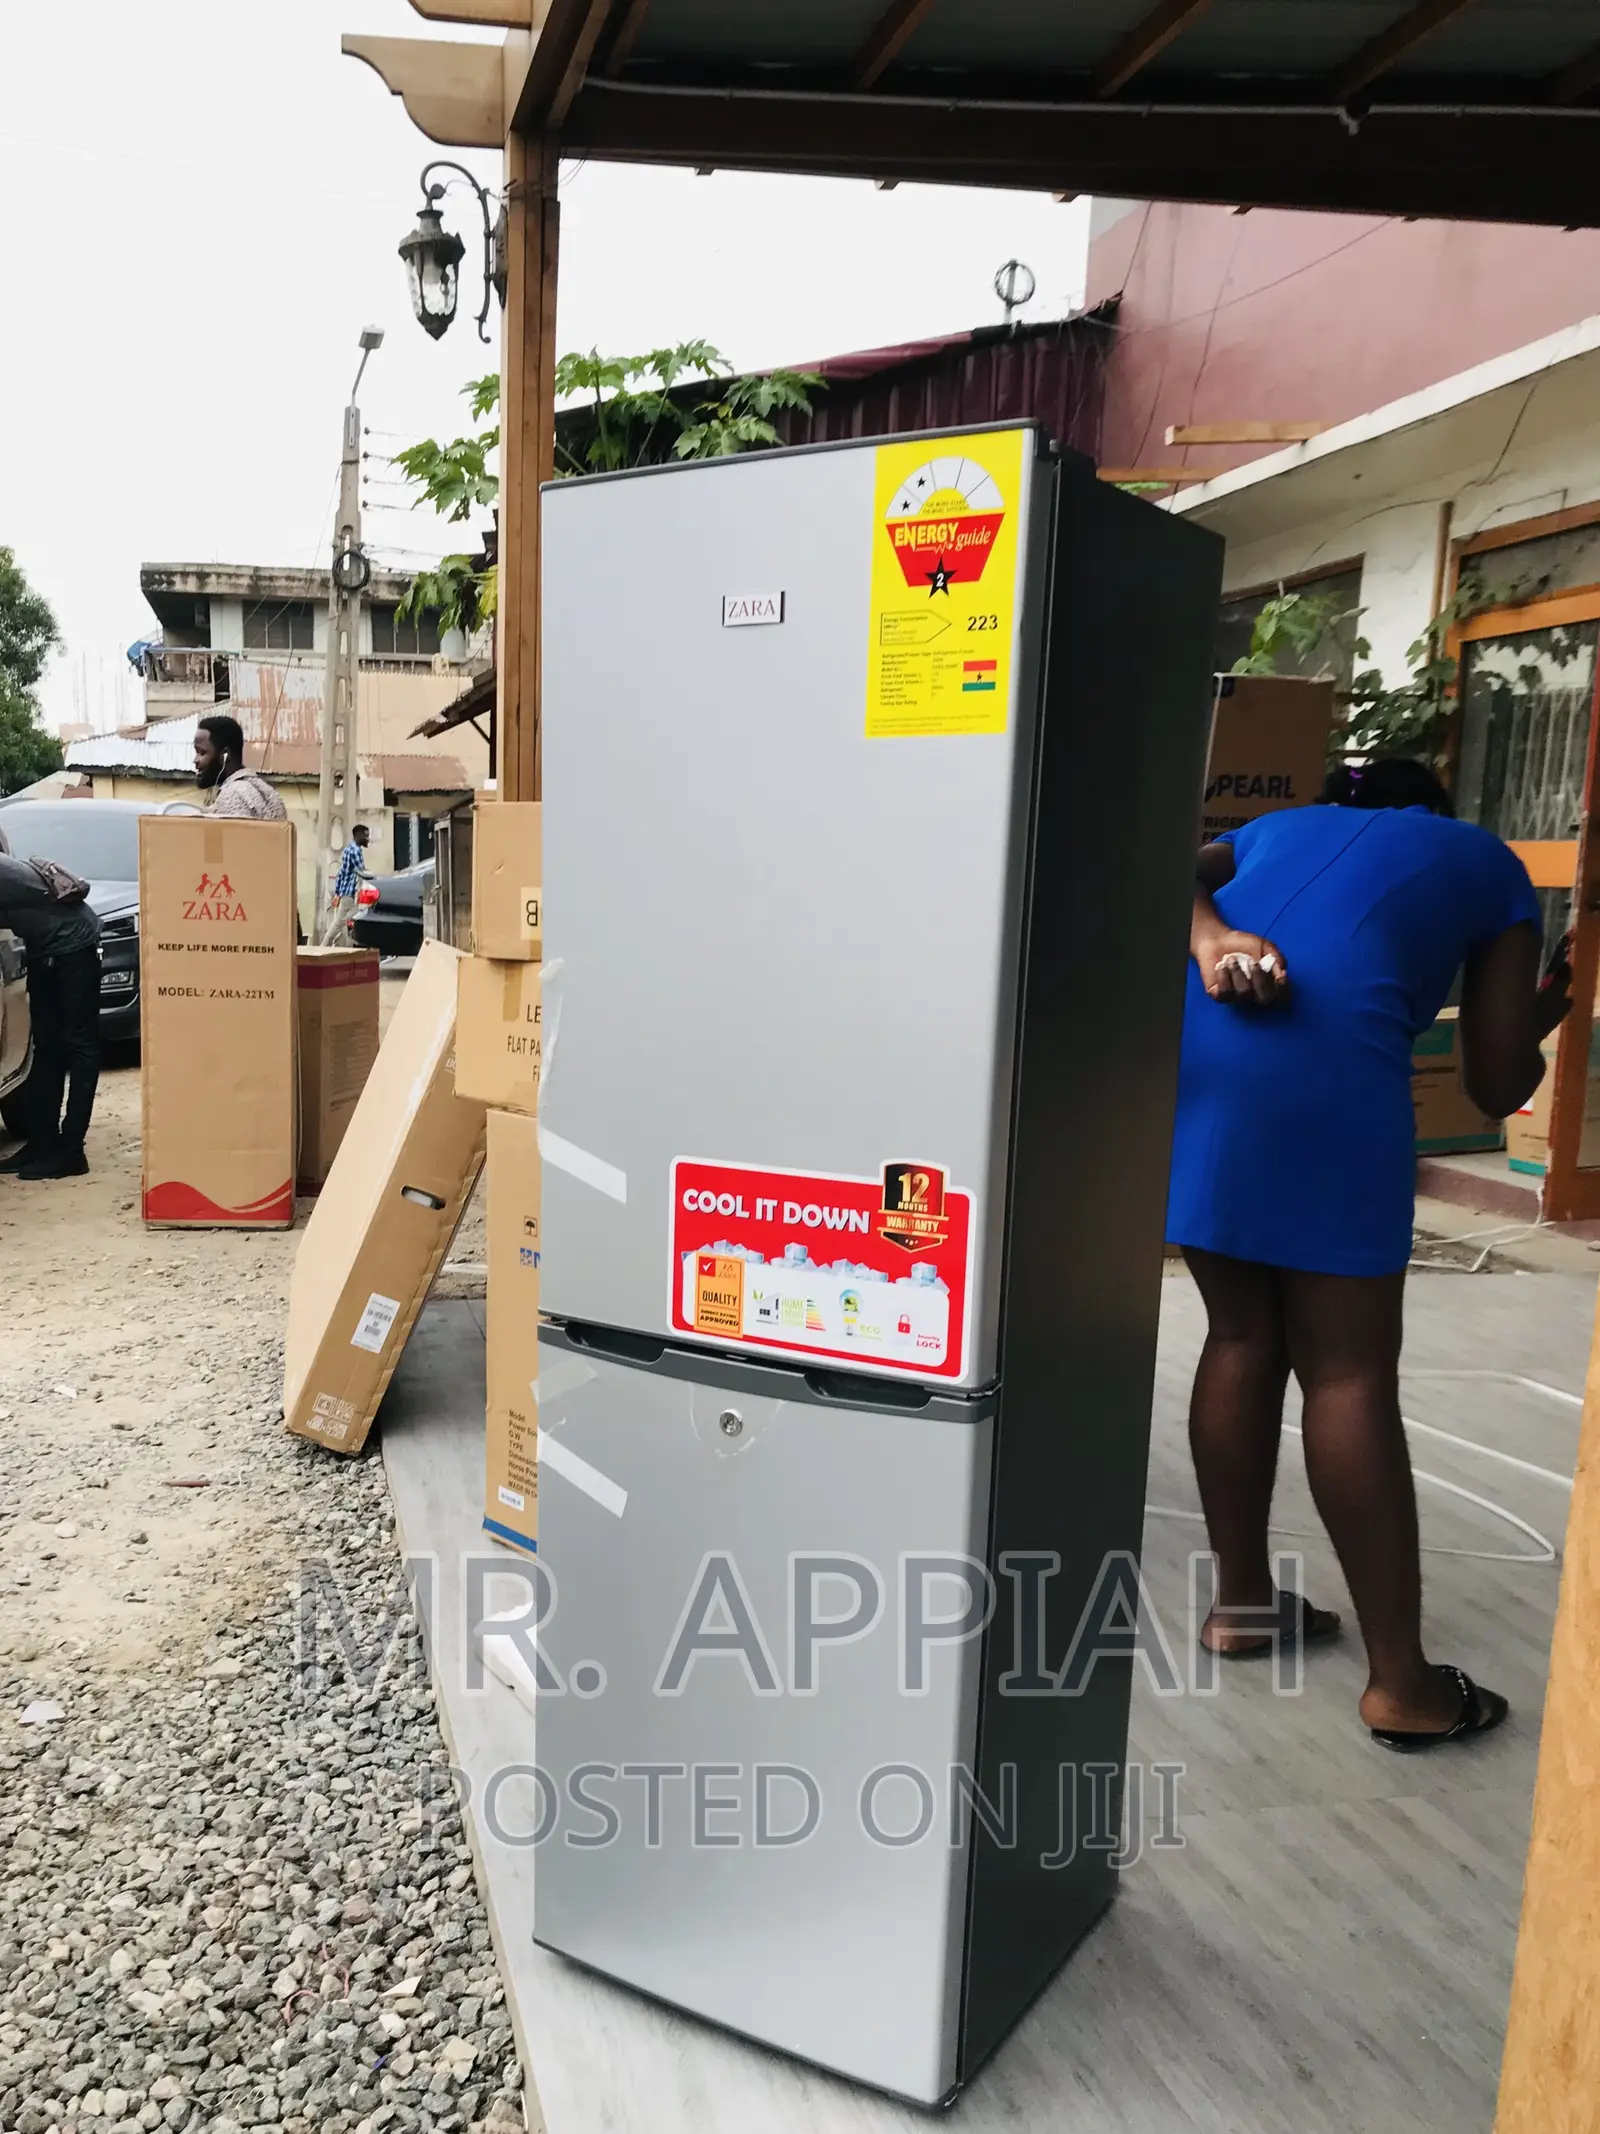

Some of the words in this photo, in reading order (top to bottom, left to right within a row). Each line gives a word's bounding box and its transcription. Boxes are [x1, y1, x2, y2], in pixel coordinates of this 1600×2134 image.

[895, 521, 959, 552] ENERGY
[955, 525, 991, 552] guide
[936, 573, 944, 587] 2
[728, 599, 775, 618] ZARA
[967, 614, 998, 631] 223
[1215, 774, 1297, 799] PEARL
[209, 883, 222, 899] Z
[182, 901, 248, 921] ZARA
[158, 943, 184, 952] KEEP
[187, 944, 208, 952] LIFE
[211, 945, 240, 953] MORE
[242, 945, 274, 954] FRESH
[158, 987, 204, 997] MODEL:
[209, 988, 274, 1000] ZARA-22TM
[507, 1035, 527, 1055] FLAT
[898, 1172, 930, 1203] 12
[682, 1188, 750, 1219] COOL
[755, 1197, 778, 1222] IT
[783, 1201, 870, 1234] DOWN
[897, 1201, 928, 1213] MONTHS
[886, 1215, 939, 1233] WARRANTY
[702, 1290, 738, 1306] QUALITY
[700, 1314, 739, 1328] APPROVED
[916, 1340, 942, 1350] LOCK
